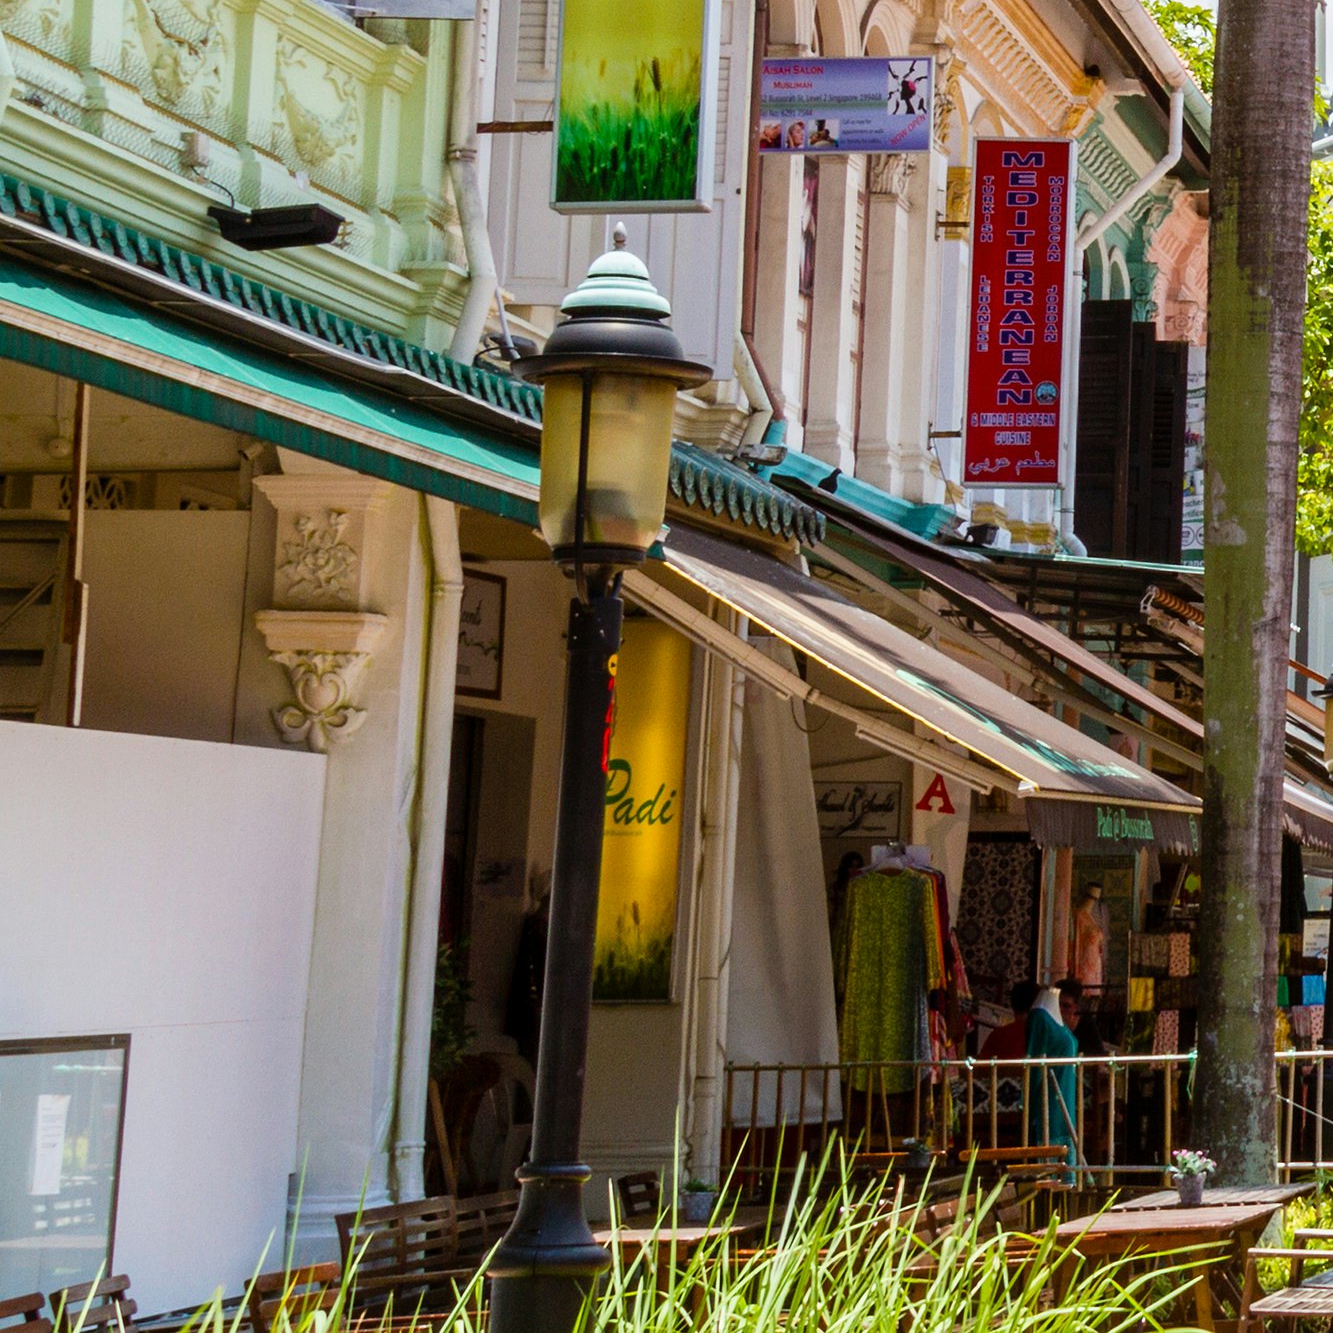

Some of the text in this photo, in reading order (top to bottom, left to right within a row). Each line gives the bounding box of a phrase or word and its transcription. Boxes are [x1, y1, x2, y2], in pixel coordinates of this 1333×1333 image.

[793, 65, 824, 75] SALON
[890, 114, 926, 147] NOW OPEN
[980, 176, 995, 242] TURKISH
[997, 151, 1045, 405] MEDITERRANEAN
[976, 275, 991, 352] LEBANESE
[1044, 285, 1058, 342] JORDAN
[980, 412, 1014, 427] MIDDLE
[1016, 412, 1056, 427] EASTERN
[994, 431, 1031, 445] CUISINE
[1016, 450, 1056, 476] مطعم
[605, 758, 677, 825] Padi
[916, 773, 956, 815] A
